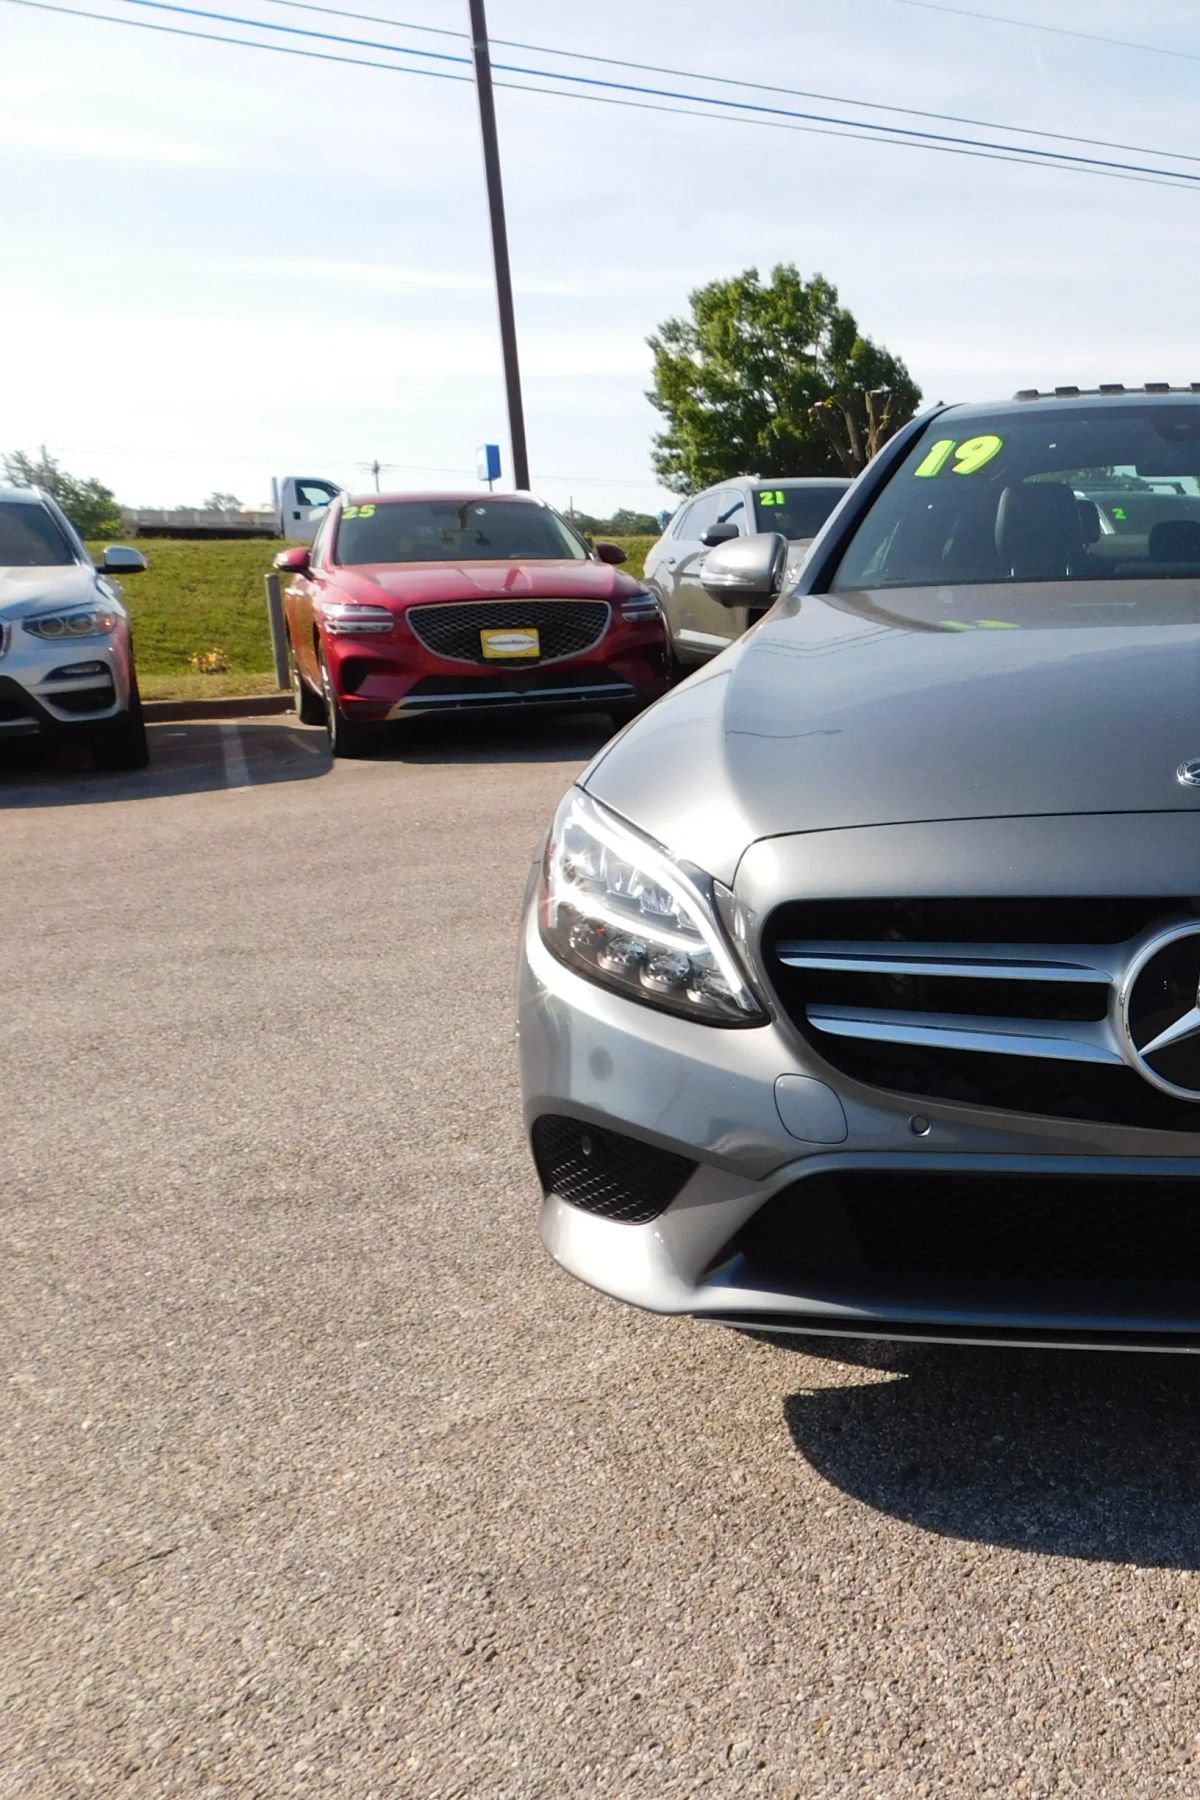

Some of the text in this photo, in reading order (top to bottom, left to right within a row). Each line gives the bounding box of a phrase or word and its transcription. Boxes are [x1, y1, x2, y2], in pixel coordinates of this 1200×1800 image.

[914, 435, 1002, 477] 19
[759, 490, 785, 506] 21
[341, 504, 376, 520] 25
